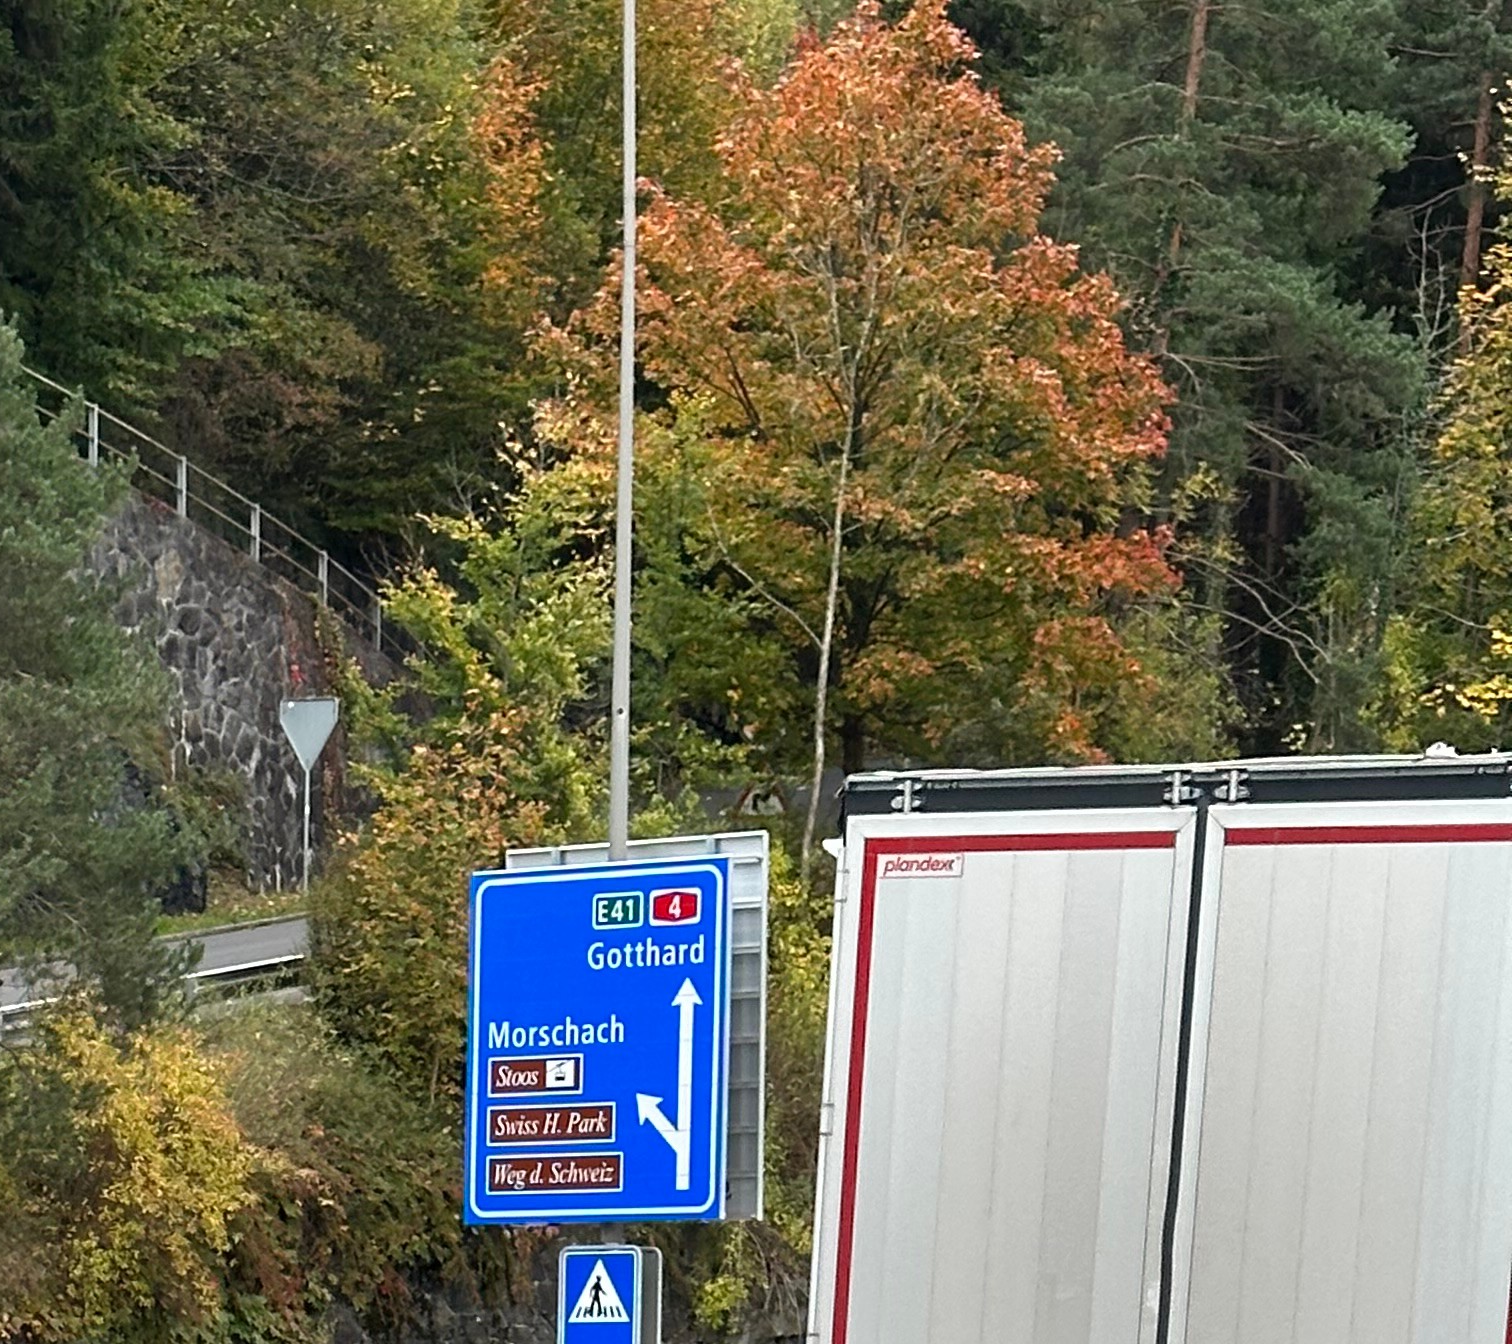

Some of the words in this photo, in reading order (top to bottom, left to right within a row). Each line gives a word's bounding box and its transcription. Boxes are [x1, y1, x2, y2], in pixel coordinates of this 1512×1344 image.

[597, 898, 635, 923] E41
[668, 894, 682, 919] 4
[587, 933, 705, 971] Gotthard
[488, 1013, 625, 1050] Morschach
[495, 1065, 540, 1088] Stoos
[494, 1114, 540, 1137] Swiss
[542, 1112, 562, 1135] H.
[566, 1110, 608, 1134] Park
[494, 1163, 528, 1191] Weg
[529, 1161, 544, 1185] d.
[548, 1160, 615, 1184] Schweiz
